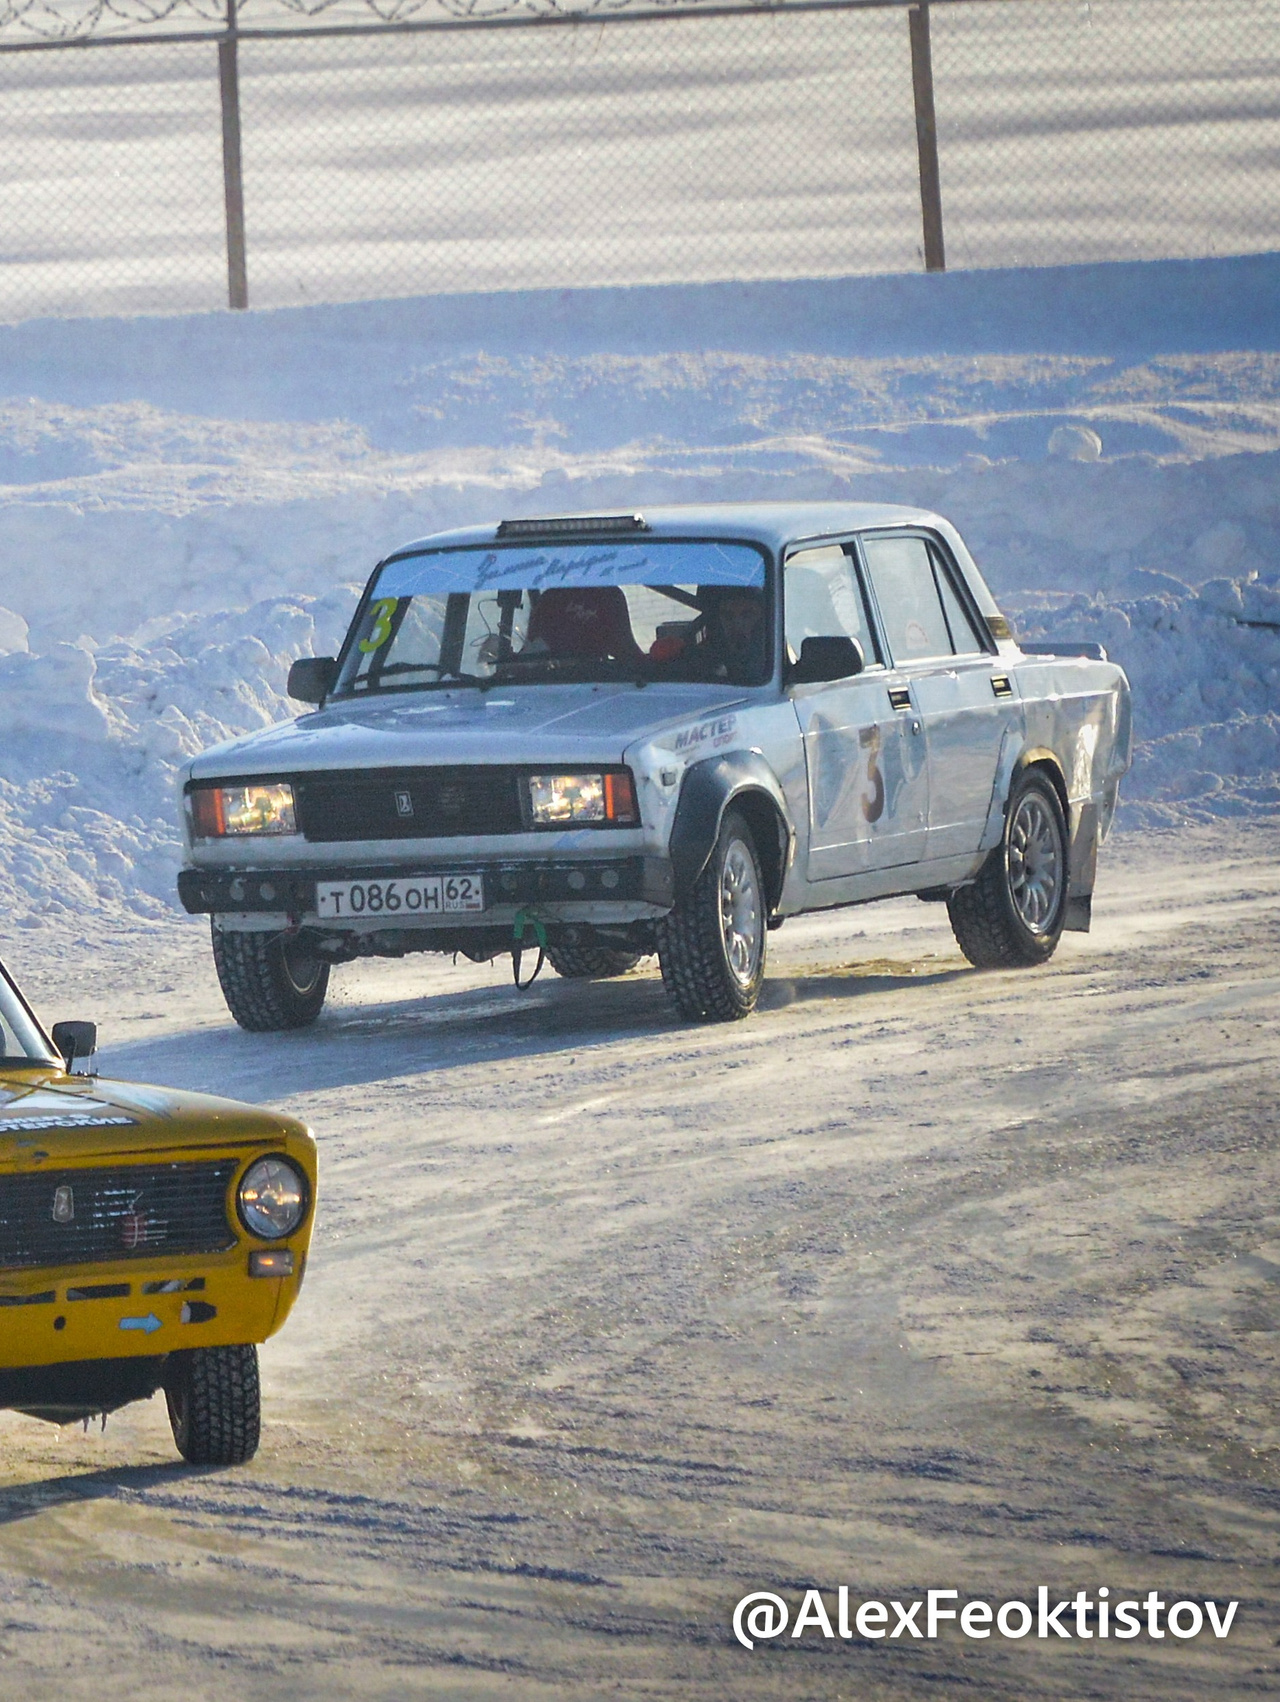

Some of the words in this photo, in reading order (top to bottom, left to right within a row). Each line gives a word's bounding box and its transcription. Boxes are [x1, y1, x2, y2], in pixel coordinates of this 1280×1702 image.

[359, 598, 398, 653] 3
[858, 723, 885, 824] 3
[446, 879, 473, 900] 62
